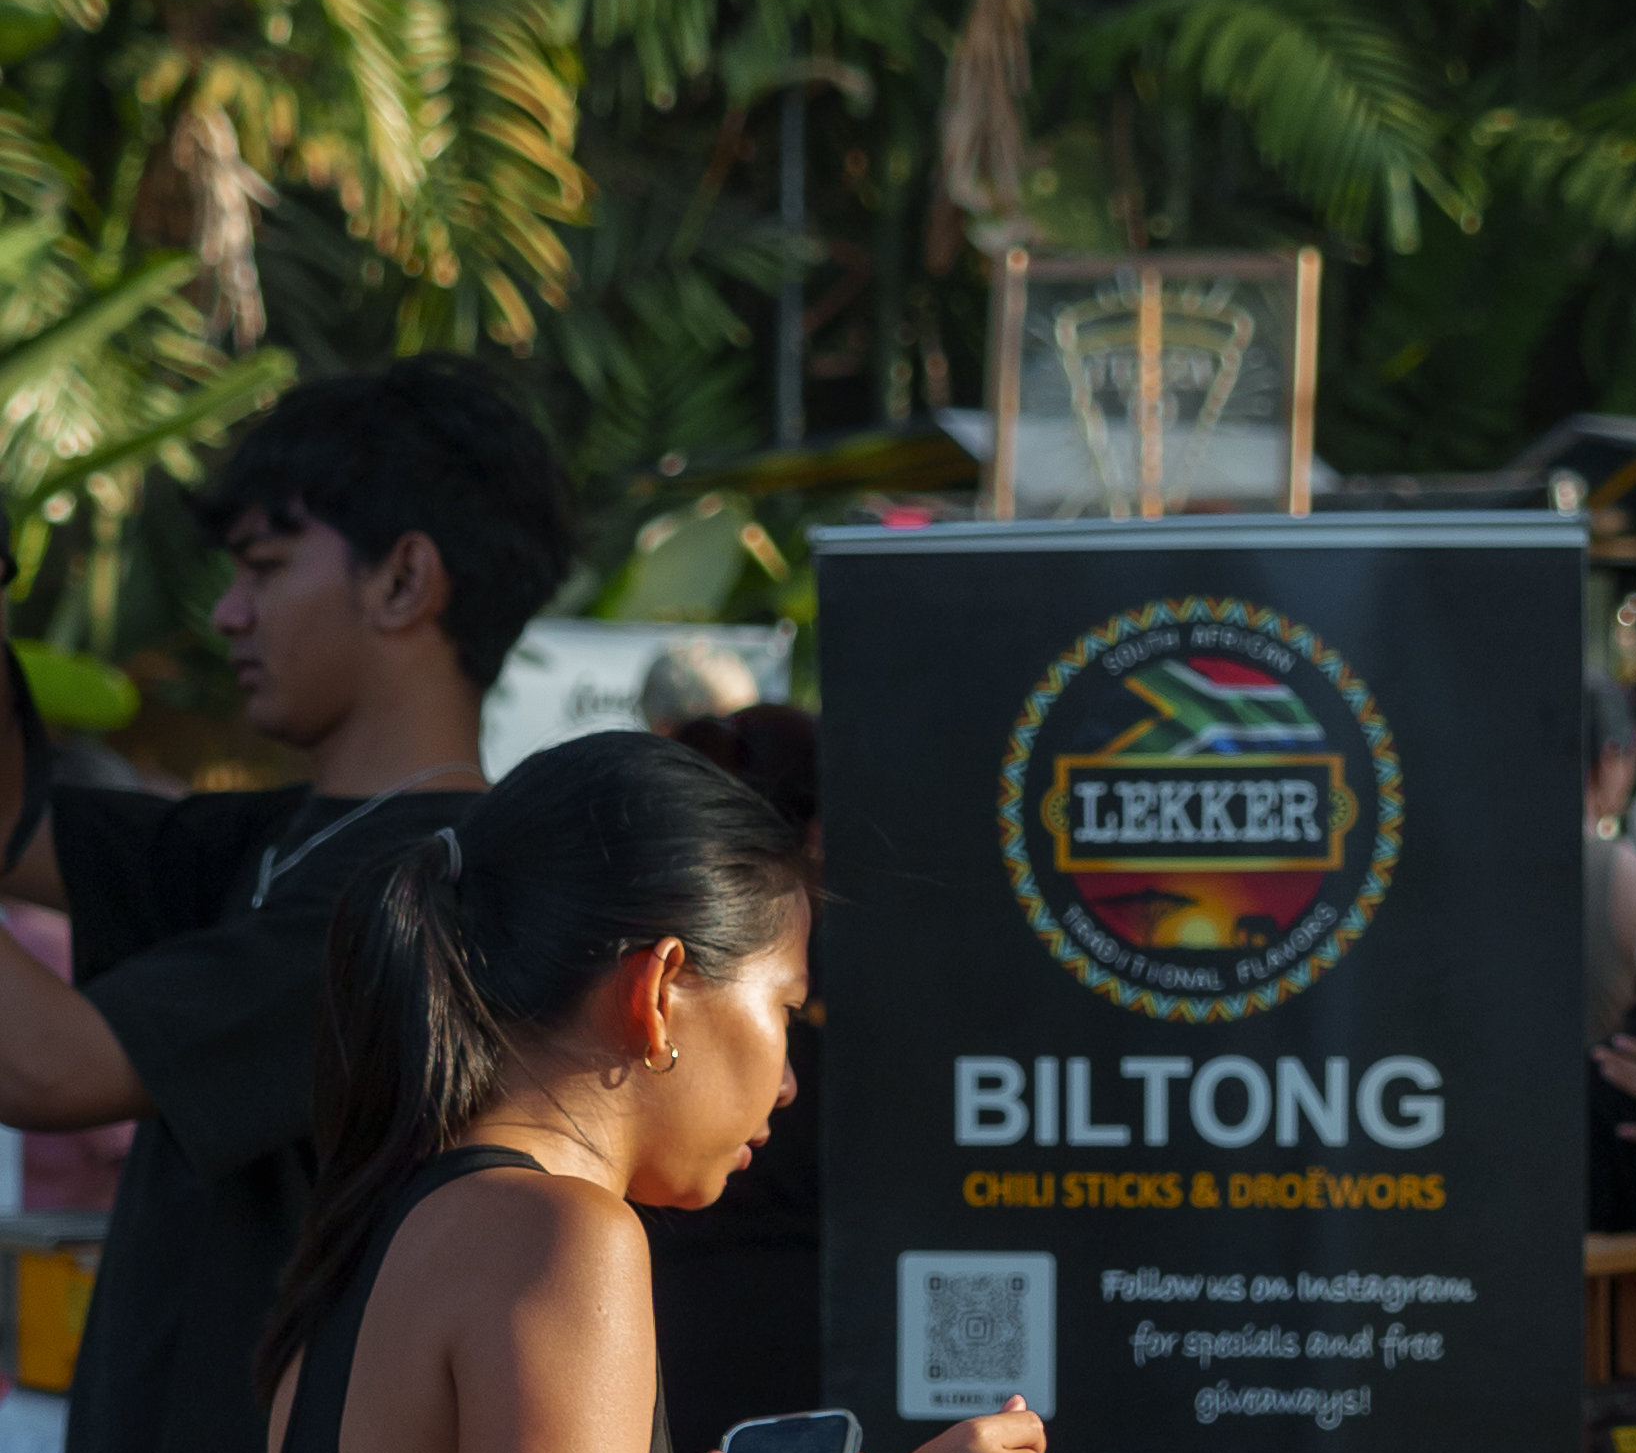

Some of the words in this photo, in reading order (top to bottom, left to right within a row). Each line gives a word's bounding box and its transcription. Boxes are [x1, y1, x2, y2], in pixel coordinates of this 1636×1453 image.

[1074, 781, 1321, 843] LEKKER
[954, 1055, 1445, 1147] BILTONG
[963, 1171, 1056, 1208] CHILI
[1061, 1171, 1183, 1208] STICKS
[1189, 1171, 1220, 1208] &
[1229, 1166, 1447, 1210] DROËWORS
[1101, 1267, 1205, 1302] Follow
[1207, 1273, 1246, 1302] us
[1250, 1276, 1294, 1302] on
[1130, 1320, 1179, 1367] for
[1183, 1323, 1302, 1368] specials
[1305, 1324, 1373, 1359] and
[1379, 1322, 1445, 1368] free
[1194, 1381, 1372, 1430] giveaways!
